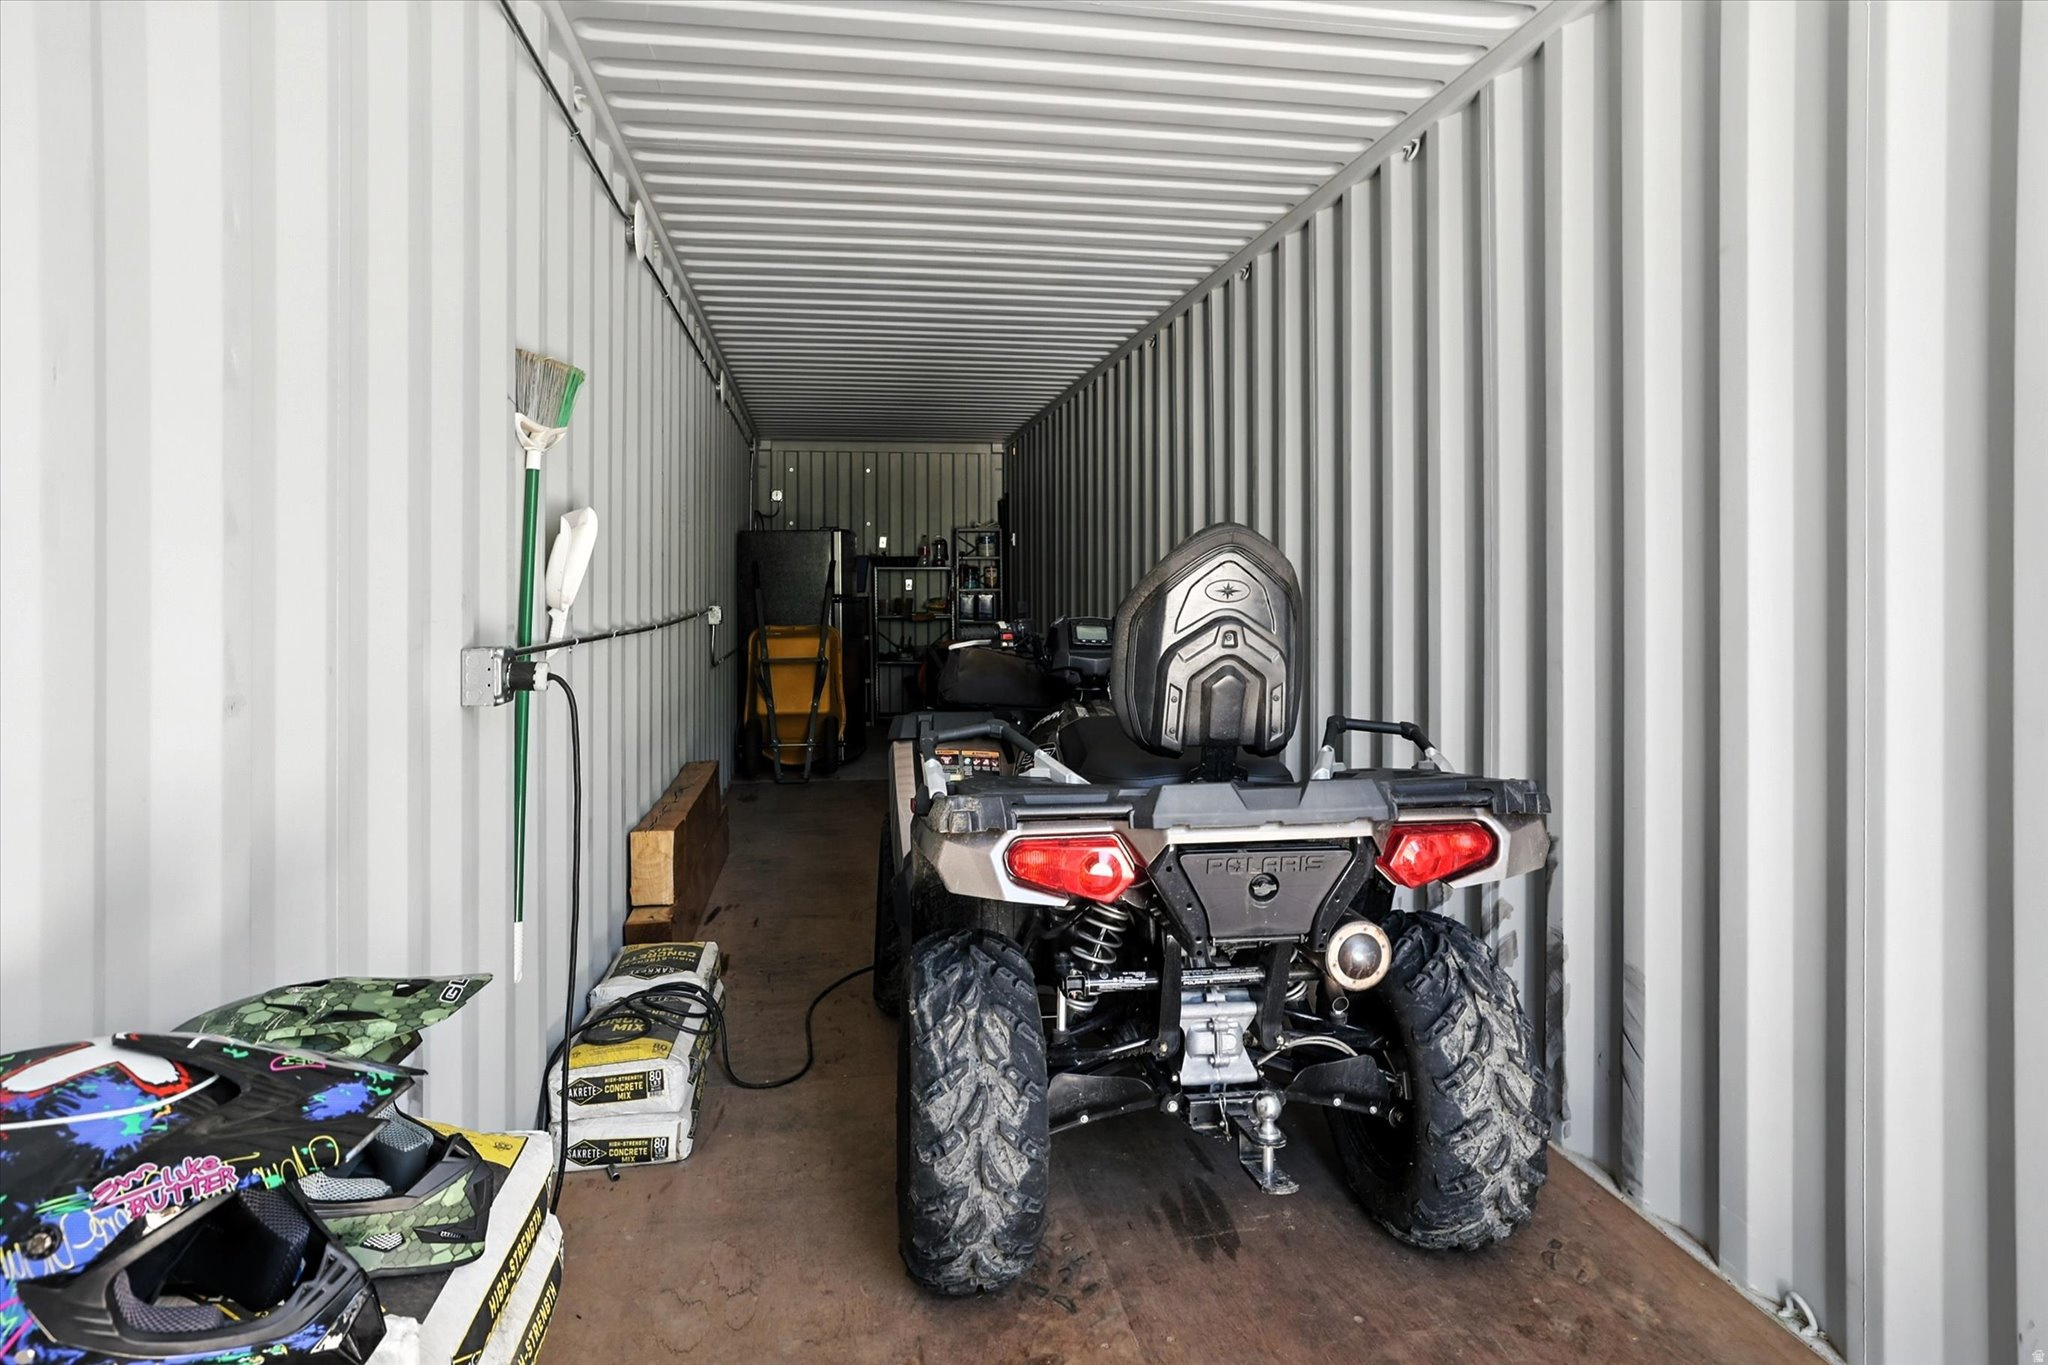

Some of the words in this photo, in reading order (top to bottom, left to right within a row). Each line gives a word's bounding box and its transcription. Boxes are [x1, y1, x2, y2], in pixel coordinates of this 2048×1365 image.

[1206, 855, 1325, 874] POLARIS
[612, 1023, 645, 1032] MIX
[604, 1074, 643, 1083] HIGH-STRENGTH
[649, 1070, 662, 1081] 80
[568, 1086, 597, 1099] AKRETE
[604, 1081, 644, 1094] CONCRETE
[617, 1091, 632, 1101] MIX
[608, 1139, 649, 1147] HIGH-STRENGTH
[654, 1137, 667, 1149] 80
[567, 1148, 601, 1159] SAKRETE
[608, 1147, 648, 1157] CONCRETE
[127, 1165, 239, 1220] BUTTER
[488, 1207, 542, 1319] HIGH-STRENGTH
[517, 1281, 558, 1365] H-STRENGTH
